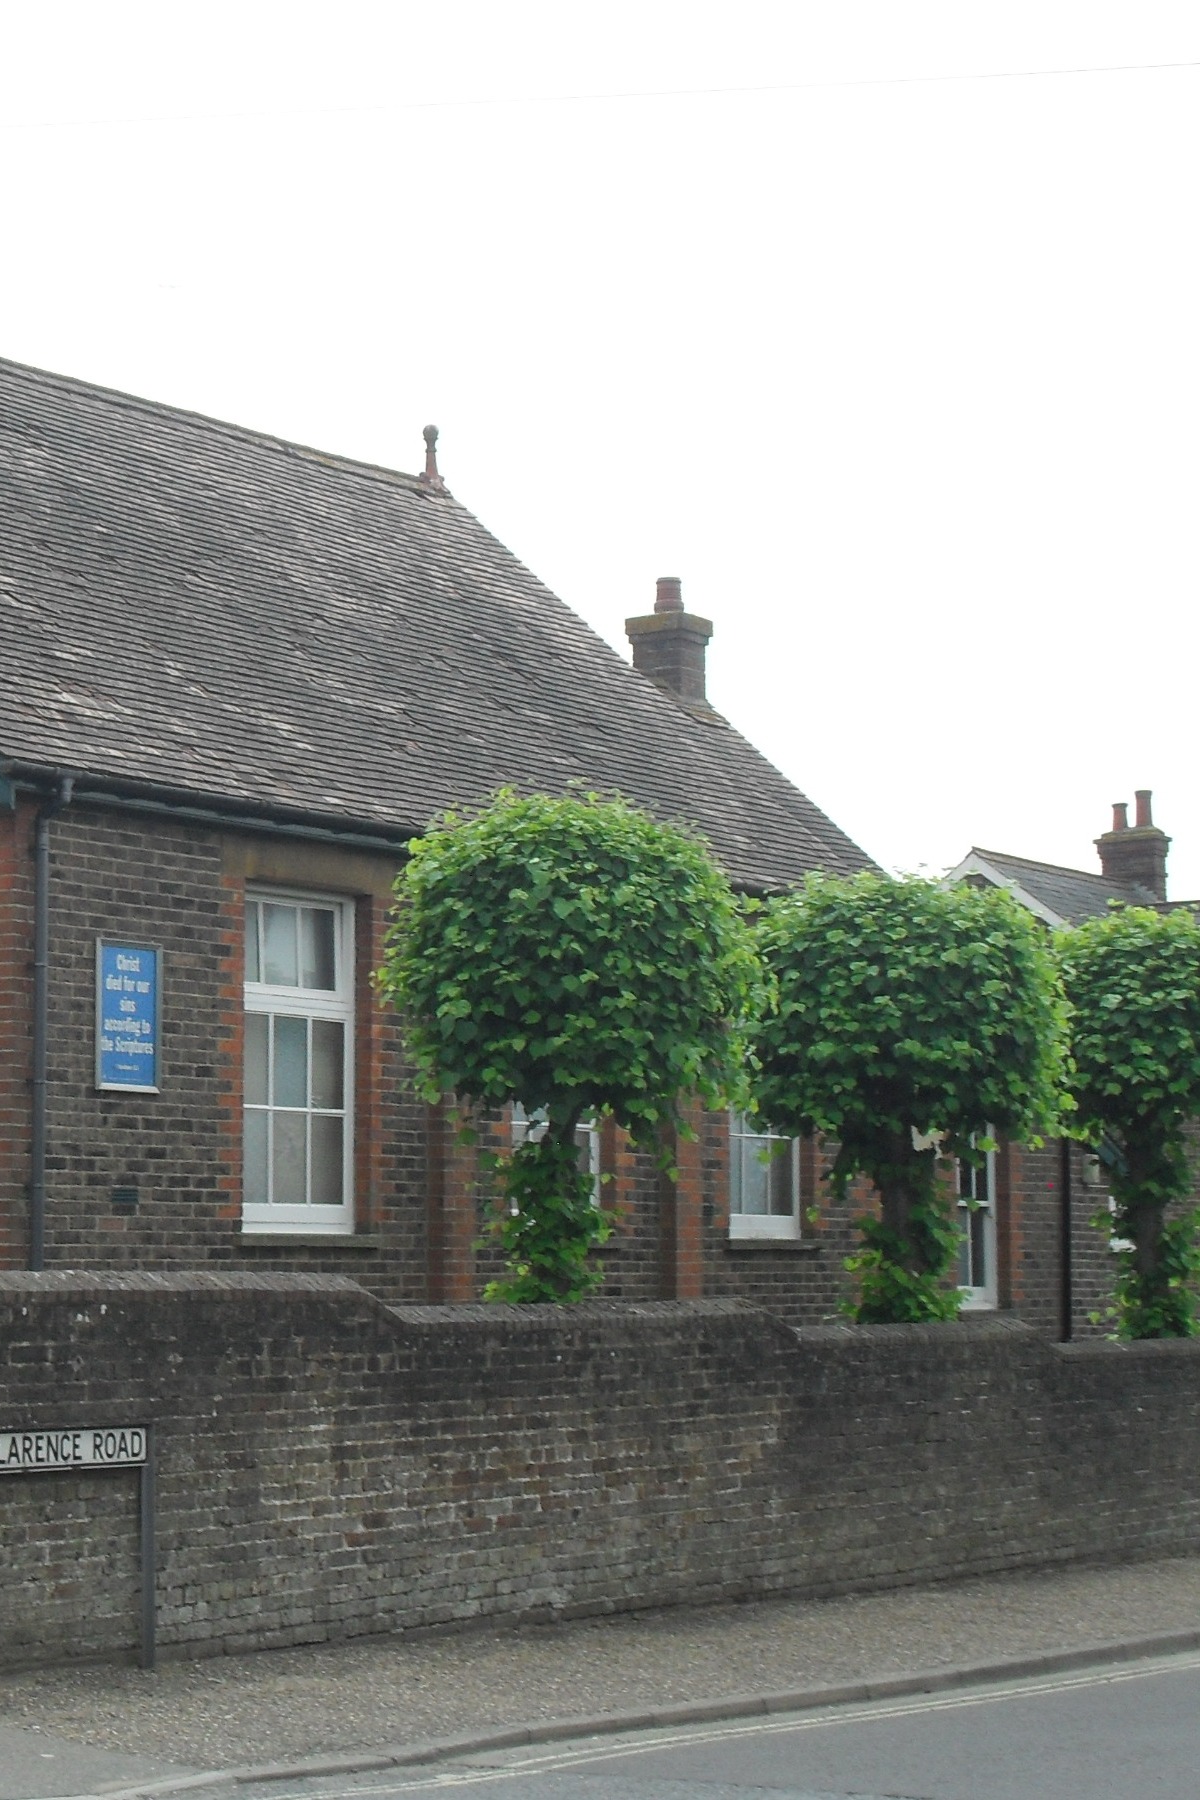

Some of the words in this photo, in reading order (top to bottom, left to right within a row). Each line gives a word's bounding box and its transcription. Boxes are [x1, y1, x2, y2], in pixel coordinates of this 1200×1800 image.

[116, 954, 140, 972] Christ
[106, 975, 122, 991] died
[123, 976, 135, 992] for
[136, 981, 151, 993] our
[119, 996, 136, 1012] sins
[104, 1017, 141, 1036] according
[142, 1019, 151, 1034] to
[101, 1036, 114, 1052] the
[115, 1037, 154, 1056] Scriptures
[92, 1431, 143, 1460] ROAD
